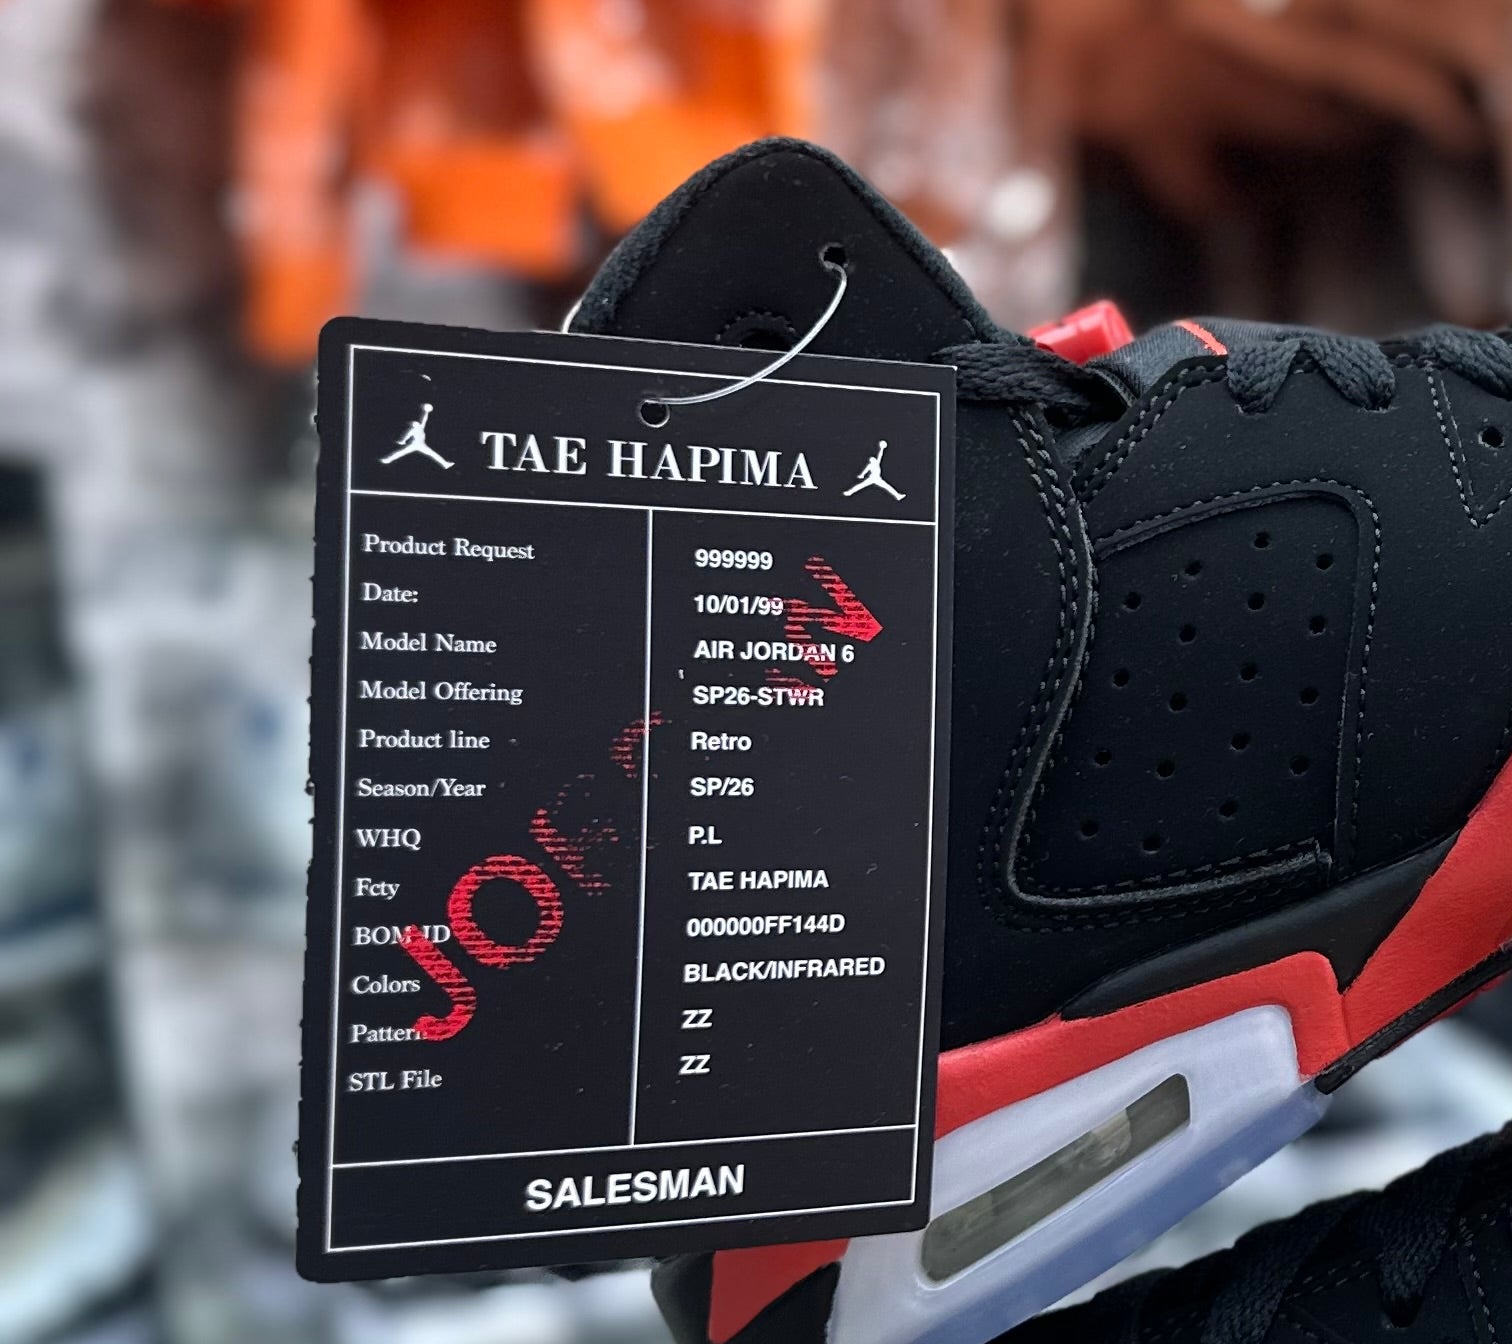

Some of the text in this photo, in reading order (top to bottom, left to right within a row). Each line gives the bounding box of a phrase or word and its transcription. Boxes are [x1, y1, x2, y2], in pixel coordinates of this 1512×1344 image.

[480, 431, 819, 490] TAE HAPIMA
[362, 533, 536, 562] Product Request
[694, 548, 774, 571] 999999
[362, 581, 419, 603] Date:
[693, 594, 784, 616] 10/01/99
[360, 630, 498, 654] Model Name
[693, 639, 855, 663] AIR JORDAN 6
[359, 679, 524, 706] Model Offering
[692, 685, 825, 707] SP26-STWR
[358, 728, 491, 749] Product line
[690, 731, 752, 751] Retro
[357, 777, 487, 797] Season/Year
[690, 776, 755, 797] SP/26
[355, 828, 422, 851] WHQ
[688, 825, 723, 845] P.L
[354, 877, 401, 901] Fcty
[687, 869, 830, 891] TAE HAPIMA
[353, 925, 412, 946] BOM
[686, 913, 846, 938] 000000FF144D
[683, 956, 886, 983] BLACK/INFRARED
[351, 974, 421, 995] Colors
[681, 1008, 713, 1029] ZZ
[350, 1023, 435, 1044] Patter
[678, 1054, 711, 1075] ZZ
[348, 1069, 443, 1092] STL File
[525, 1163, 745, 1211] SALESMAN
